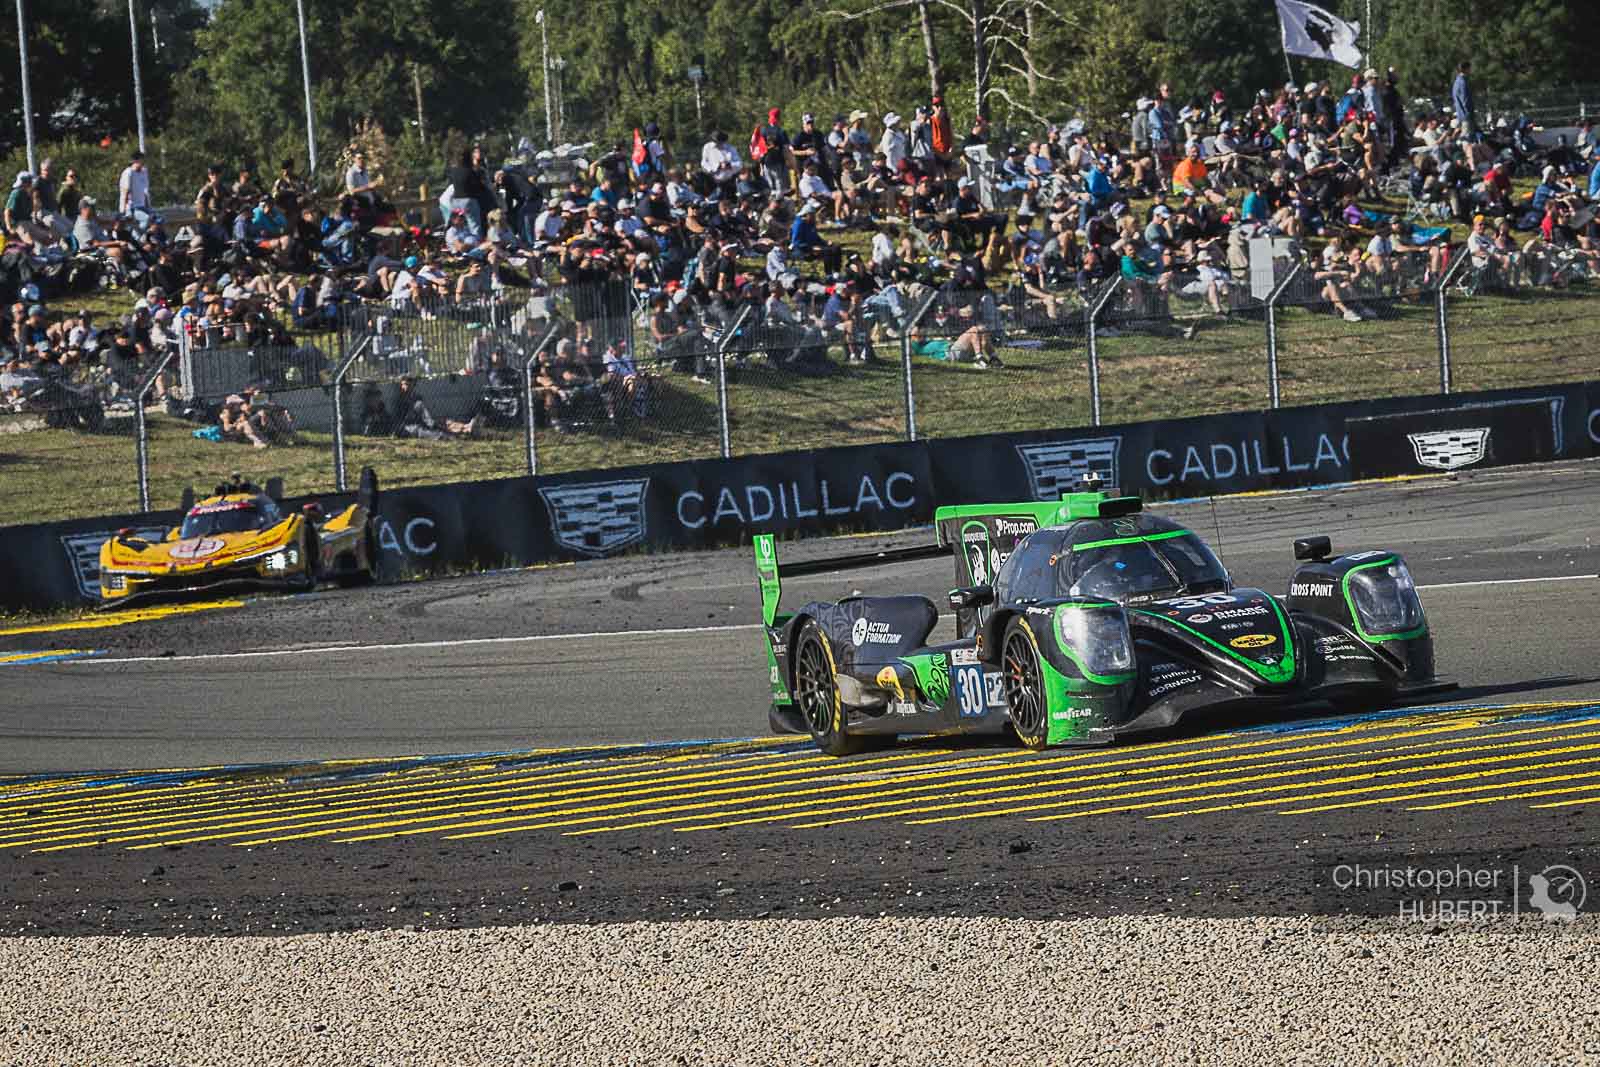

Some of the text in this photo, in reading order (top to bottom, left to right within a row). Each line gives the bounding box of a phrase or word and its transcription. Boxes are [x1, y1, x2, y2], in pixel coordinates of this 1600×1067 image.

[1147, 433, 1350, 485] CADILLA
[677, 472, 915, 529] CADILLAC
[1003, 520, 1035, 536] Prop.com
[1291, 583, 1334, 597] CROSS POINT
[866, 632, 902, 644] FORMATION
[868, 622, 890, 633] ACTUA
[957, 668, 983, 715] 30
[986, 674, 1006, 704] P2
